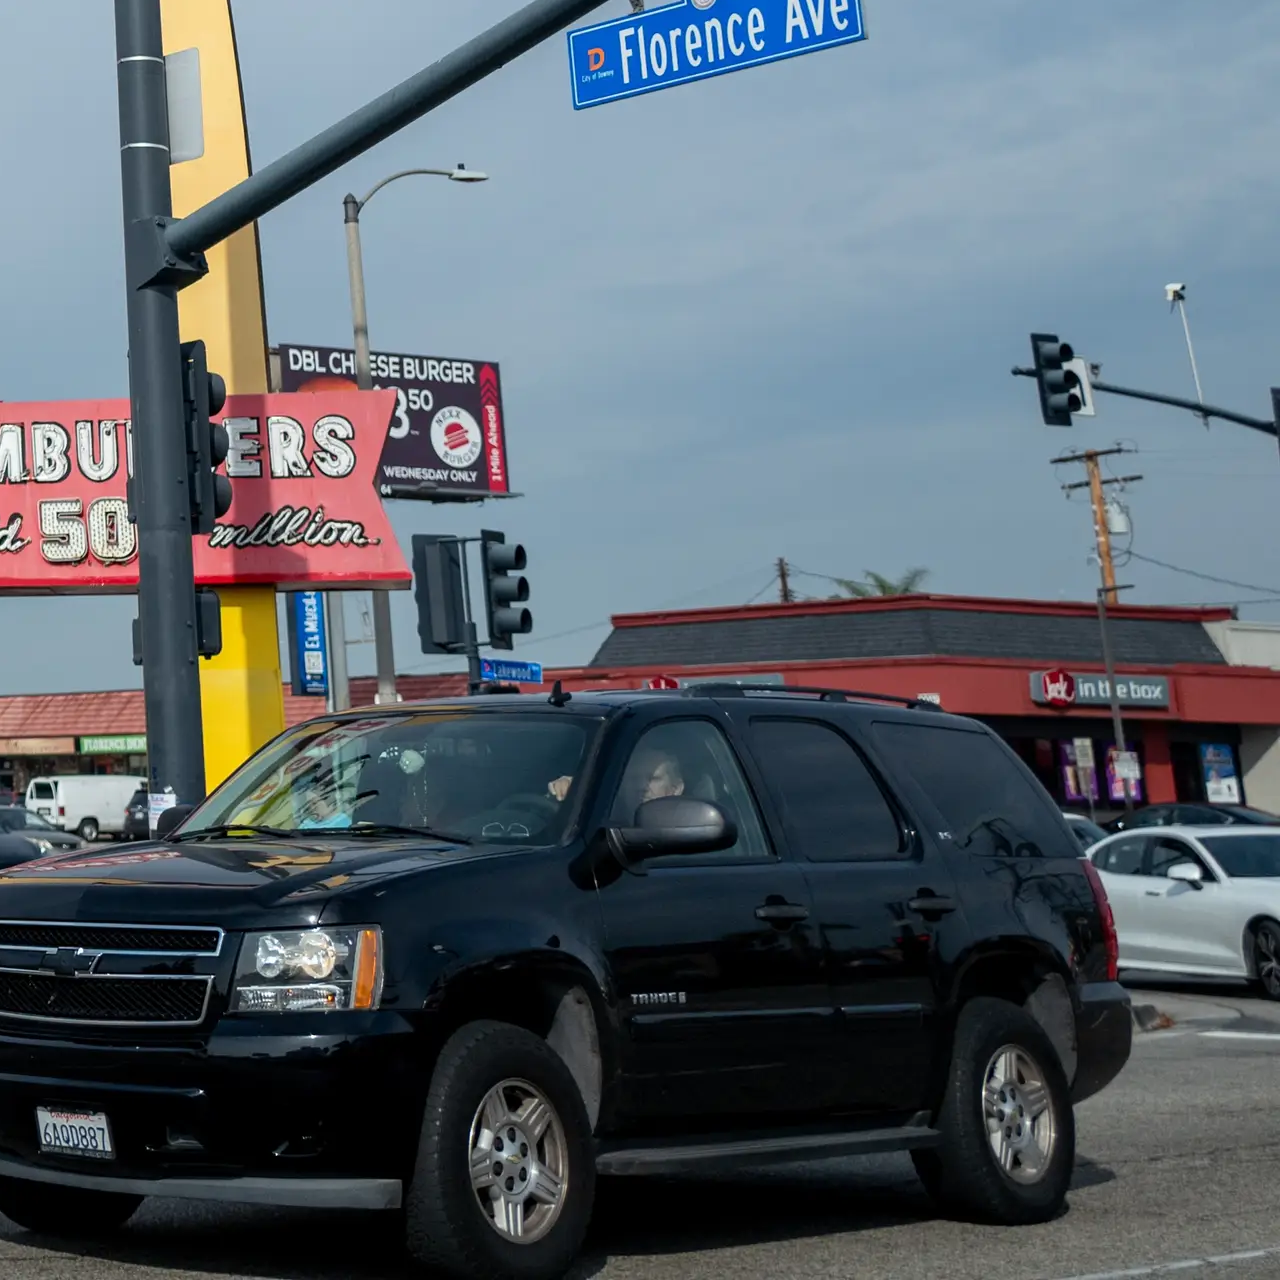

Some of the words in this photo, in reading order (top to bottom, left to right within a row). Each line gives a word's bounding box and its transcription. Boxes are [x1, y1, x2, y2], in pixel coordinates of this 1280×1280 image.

[619, 6, 766, 84] Florence
[288, 348, 326, 372] DBL
[329, 351, 401, 379] CHESE
[403, 358, 476, 385] BURGER
[485, 405, 498, 446] Ahead
[489, 448, 501, 474] Mile
[383, 465, 449, 482] WEDNESDAY
[450, 470, 478, 488] ONLY
[38, 497, 138, 566] 50
[1078, 680, 1096, 697] in
[1129, 682, 1163, 699] box
[630, 992, 677, 1005] TAHOE
[43, 1122, 106, 1152] 6AQD887
